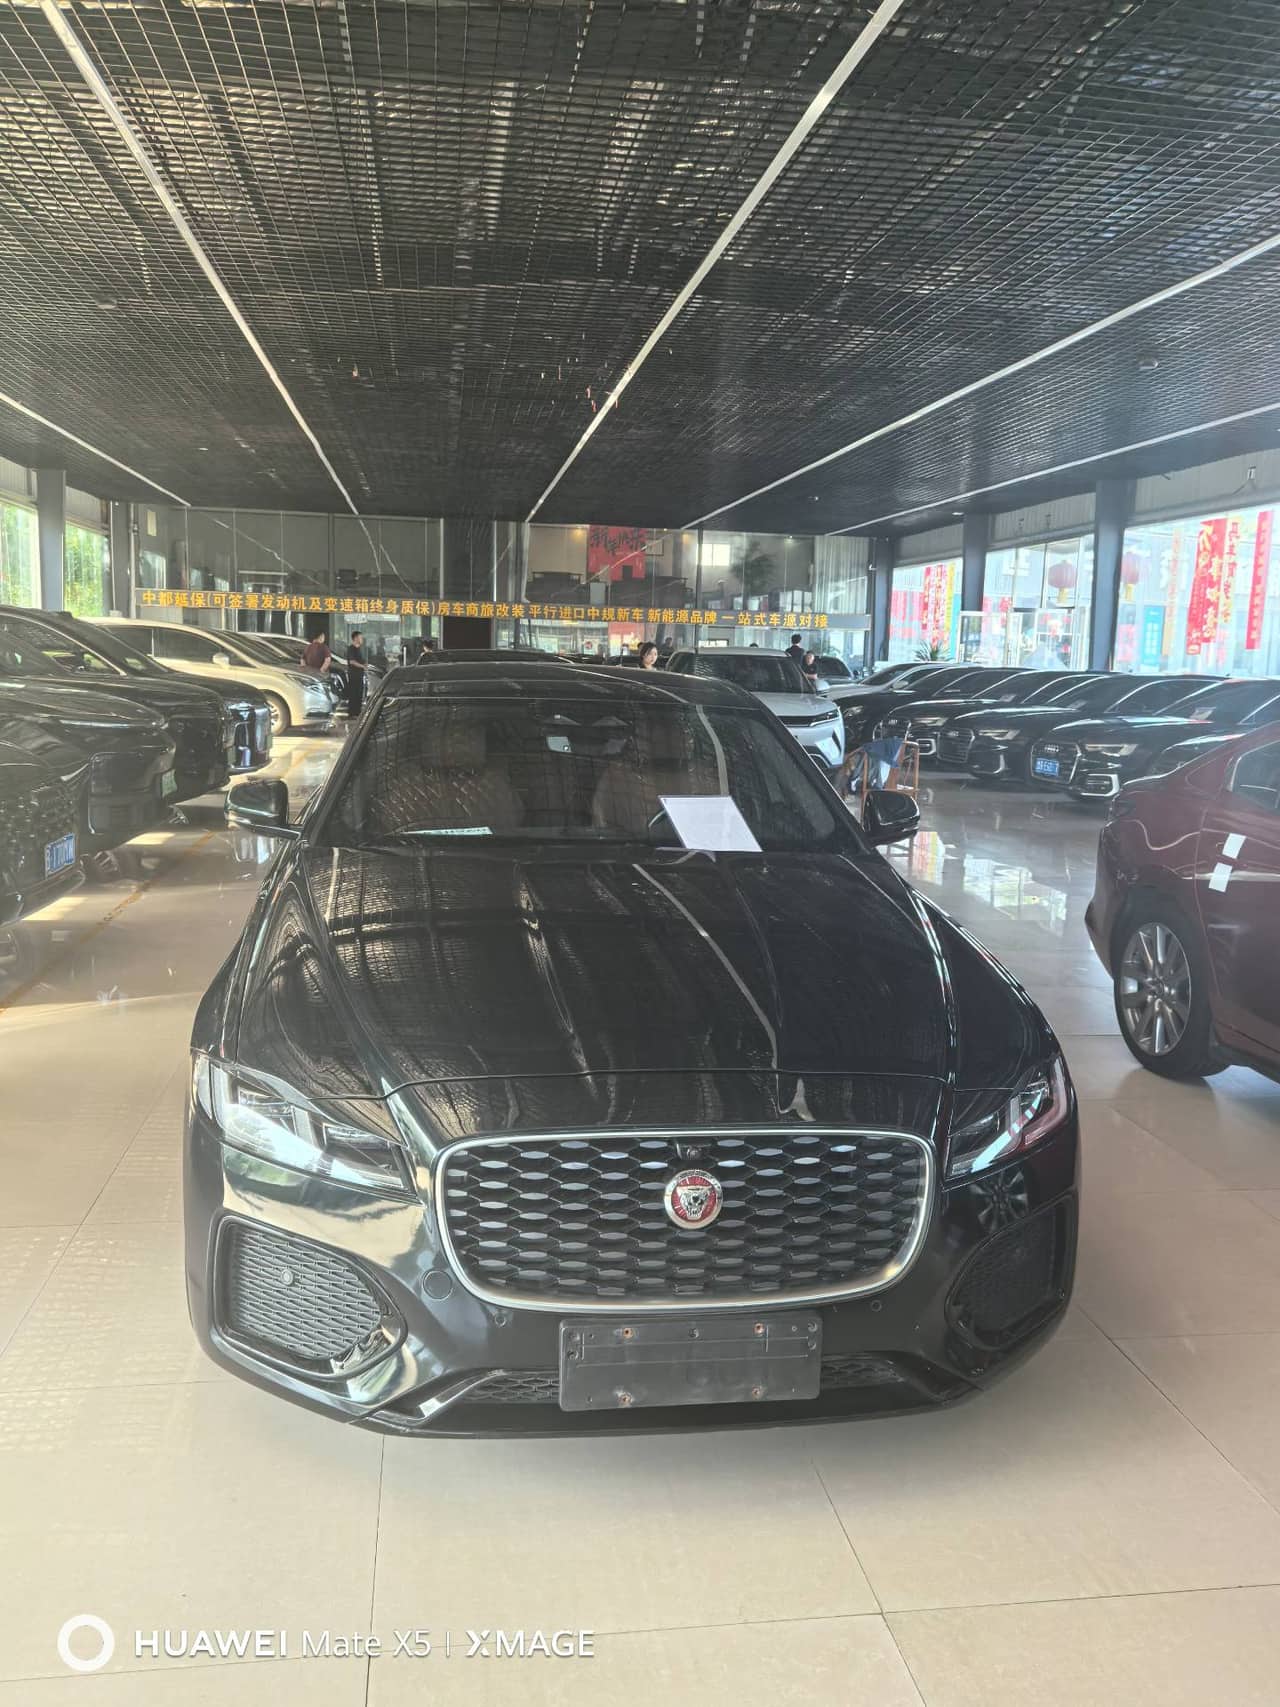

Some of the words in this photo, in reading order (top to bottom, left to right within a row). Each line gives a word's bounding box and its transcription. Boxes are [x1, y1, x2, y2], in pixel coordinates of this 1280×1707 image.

[647, 608, 717, 625] 新能源品牌
